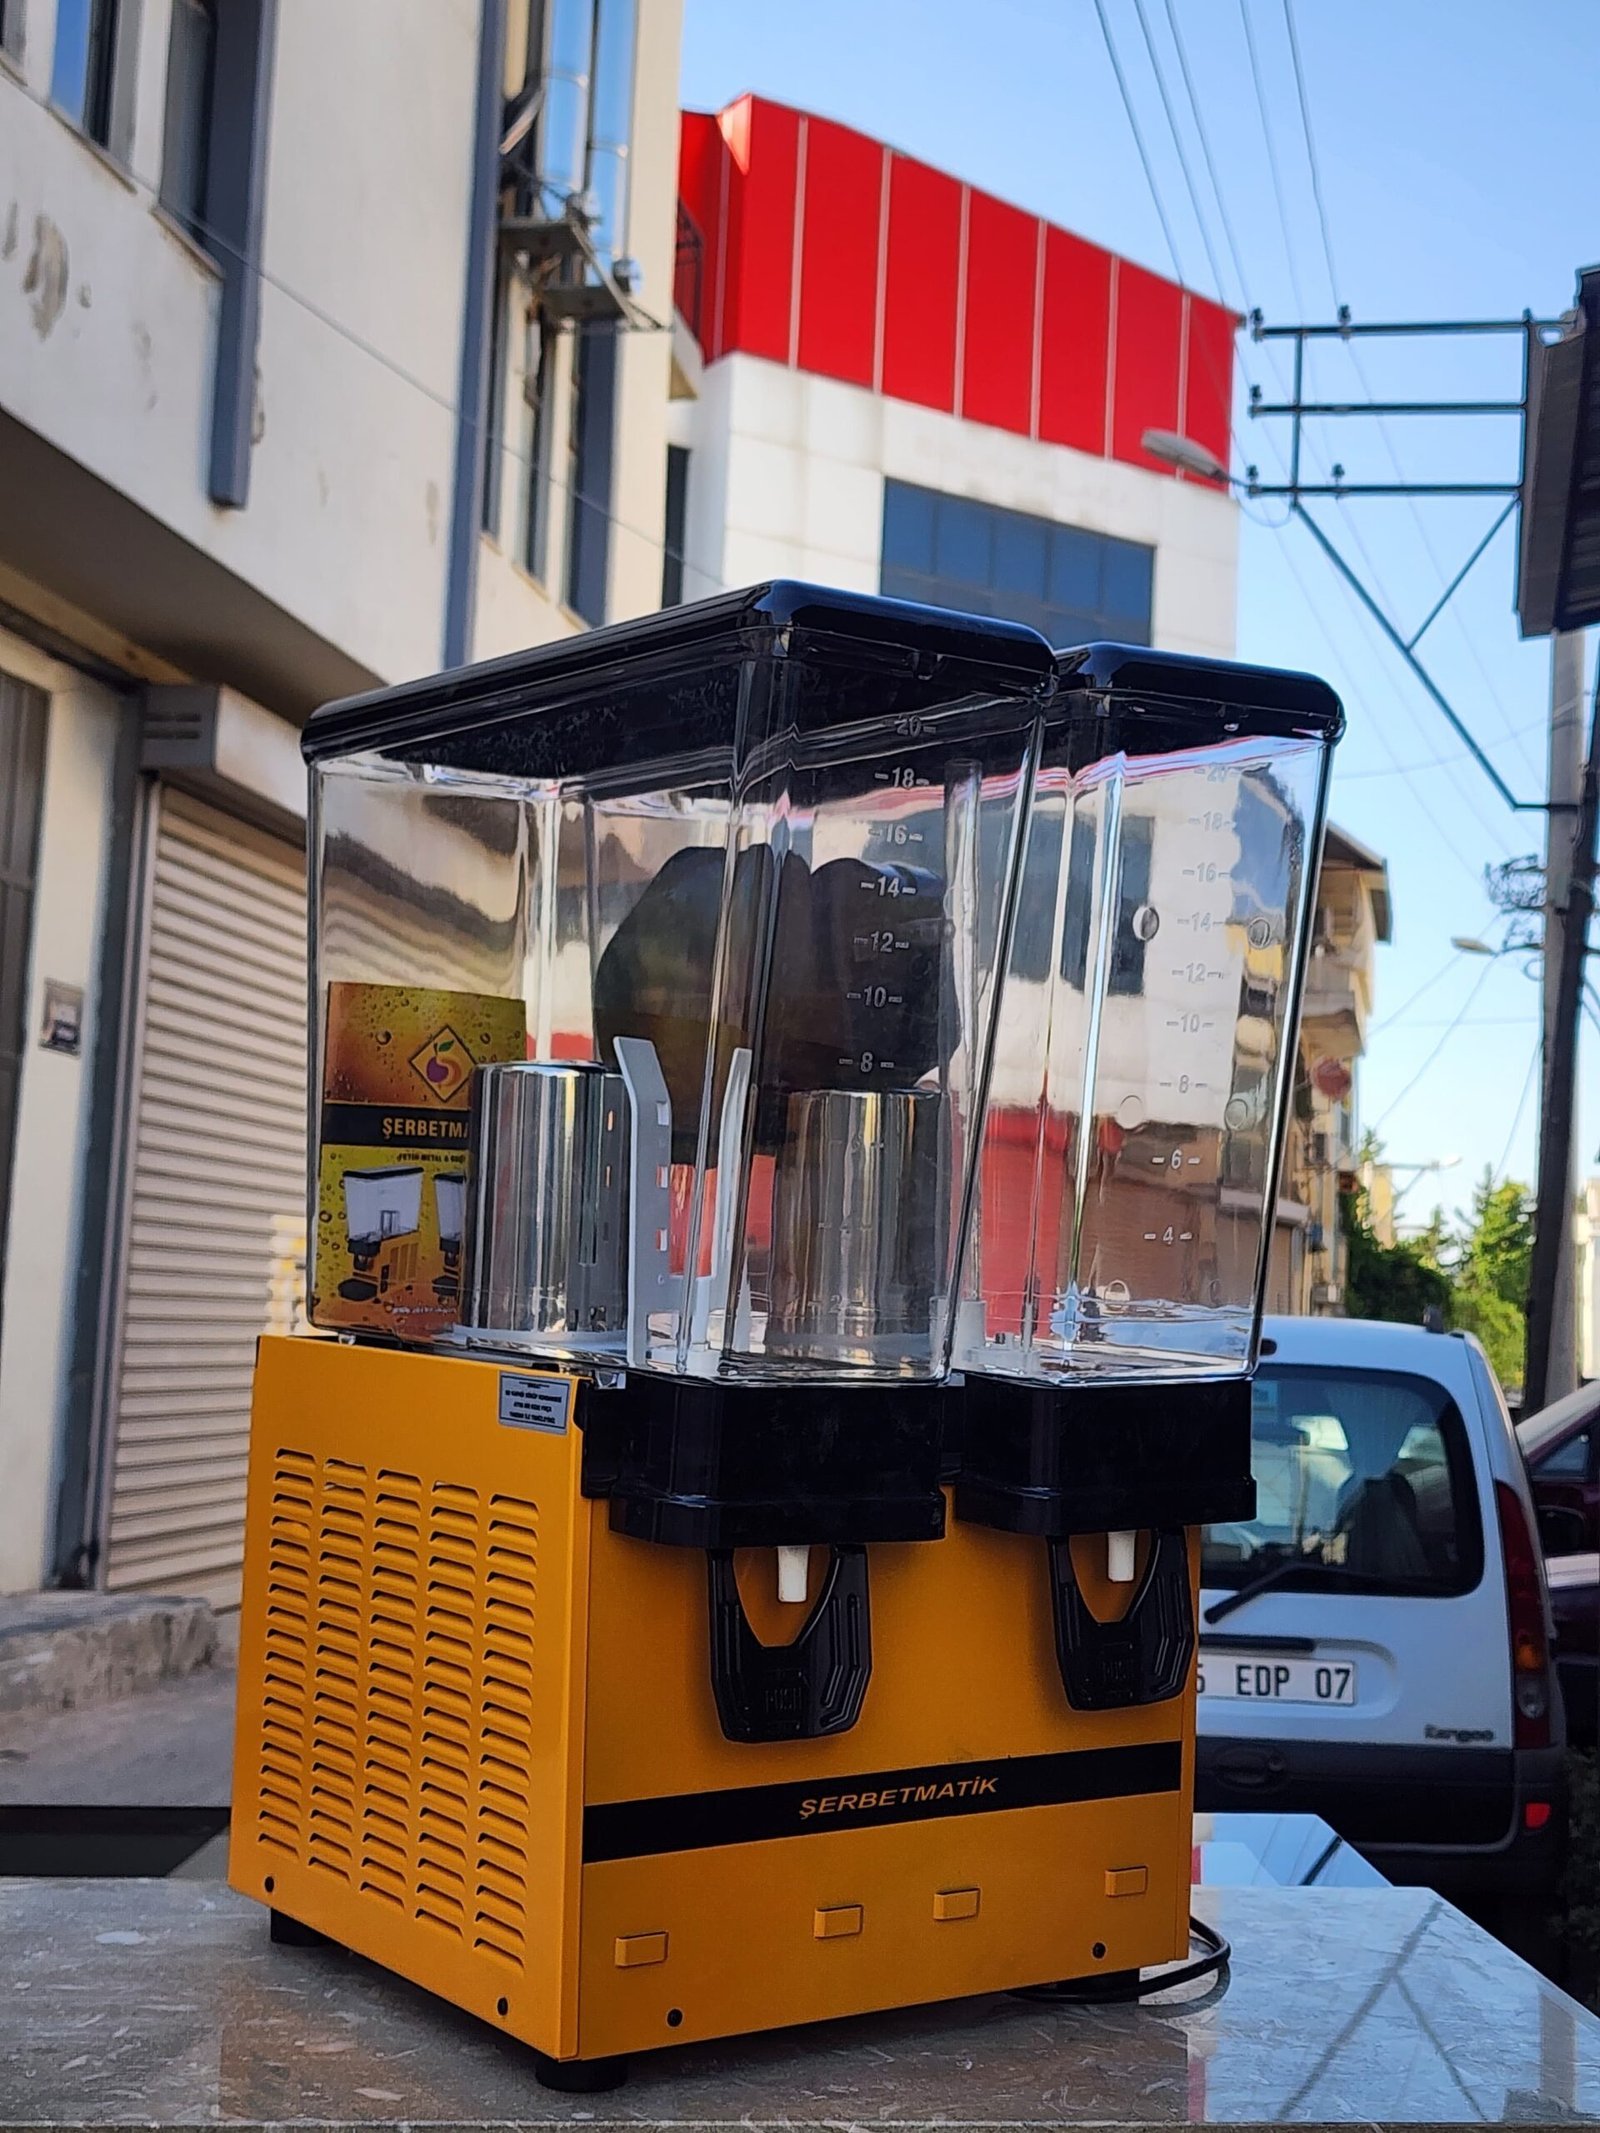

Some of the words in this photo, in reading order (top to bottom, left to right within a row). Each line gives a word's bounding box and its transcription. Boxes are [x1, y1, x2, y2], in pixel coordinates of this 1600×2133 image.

[1236, 1664, 1290, 1697] EDP
[1315, 1668, 1351, 1699] 07
[799, 1776, 999, 1820] ŞERBETMATİK
